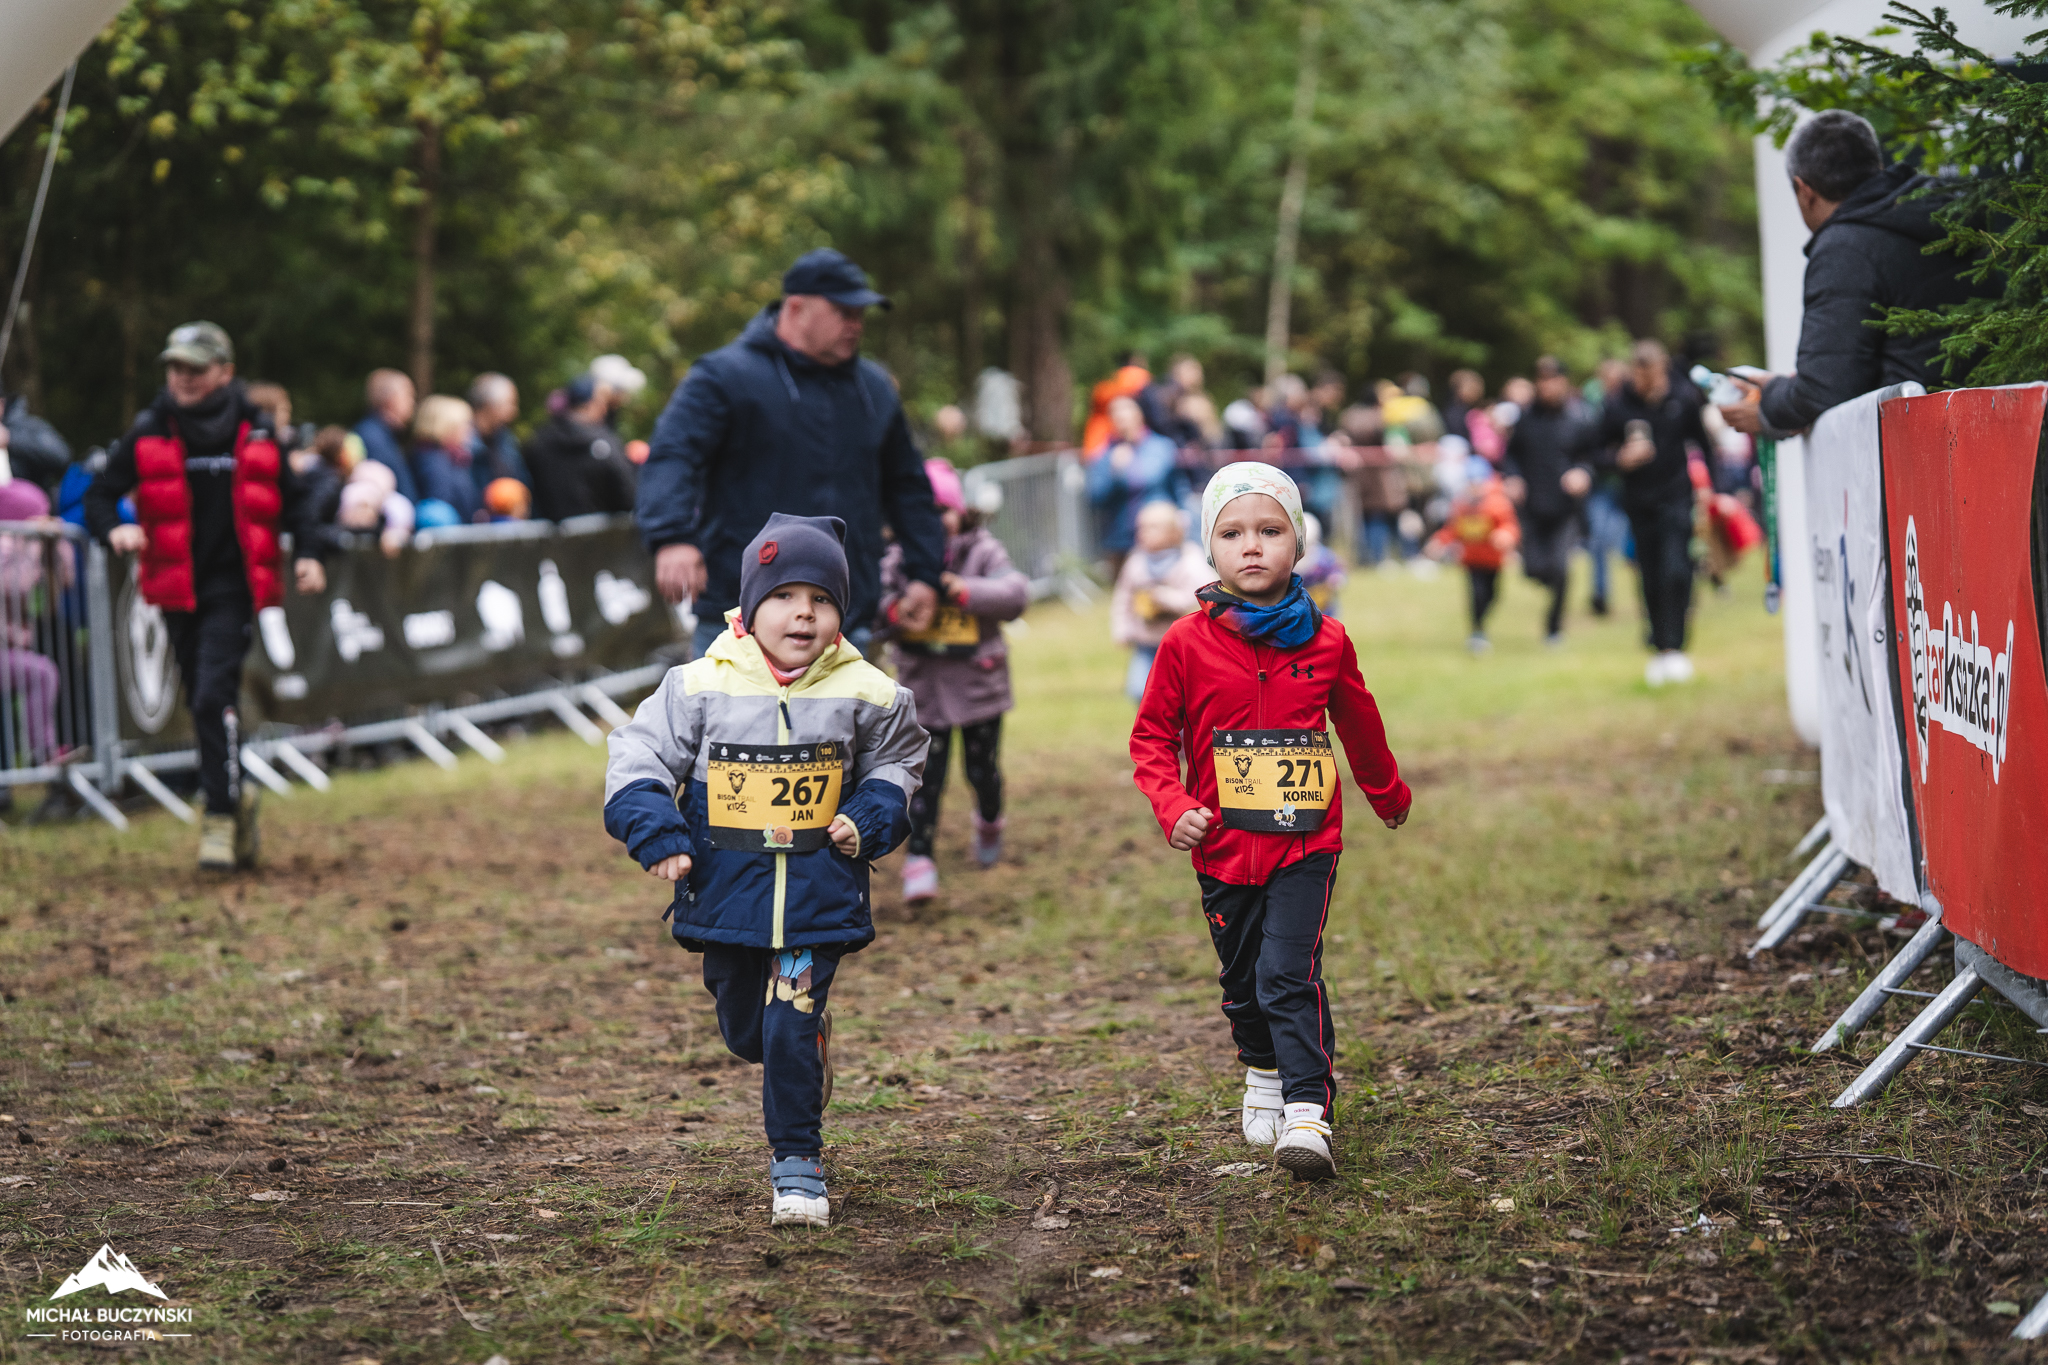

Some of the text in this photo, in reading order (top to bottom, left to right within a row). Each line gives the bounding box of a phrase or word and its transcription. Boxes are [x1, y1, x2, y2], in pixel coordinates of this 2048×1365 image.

[1277, 759, 1324, 787] 271
[771, 775, 829, 806] 267
[1235, 784, 1254, 795] KIDS
[1283, 791, 1324, 802] KORNEL
[727, 801, 747, 813] KIDS
[791, 809, 814, 822] JAN
